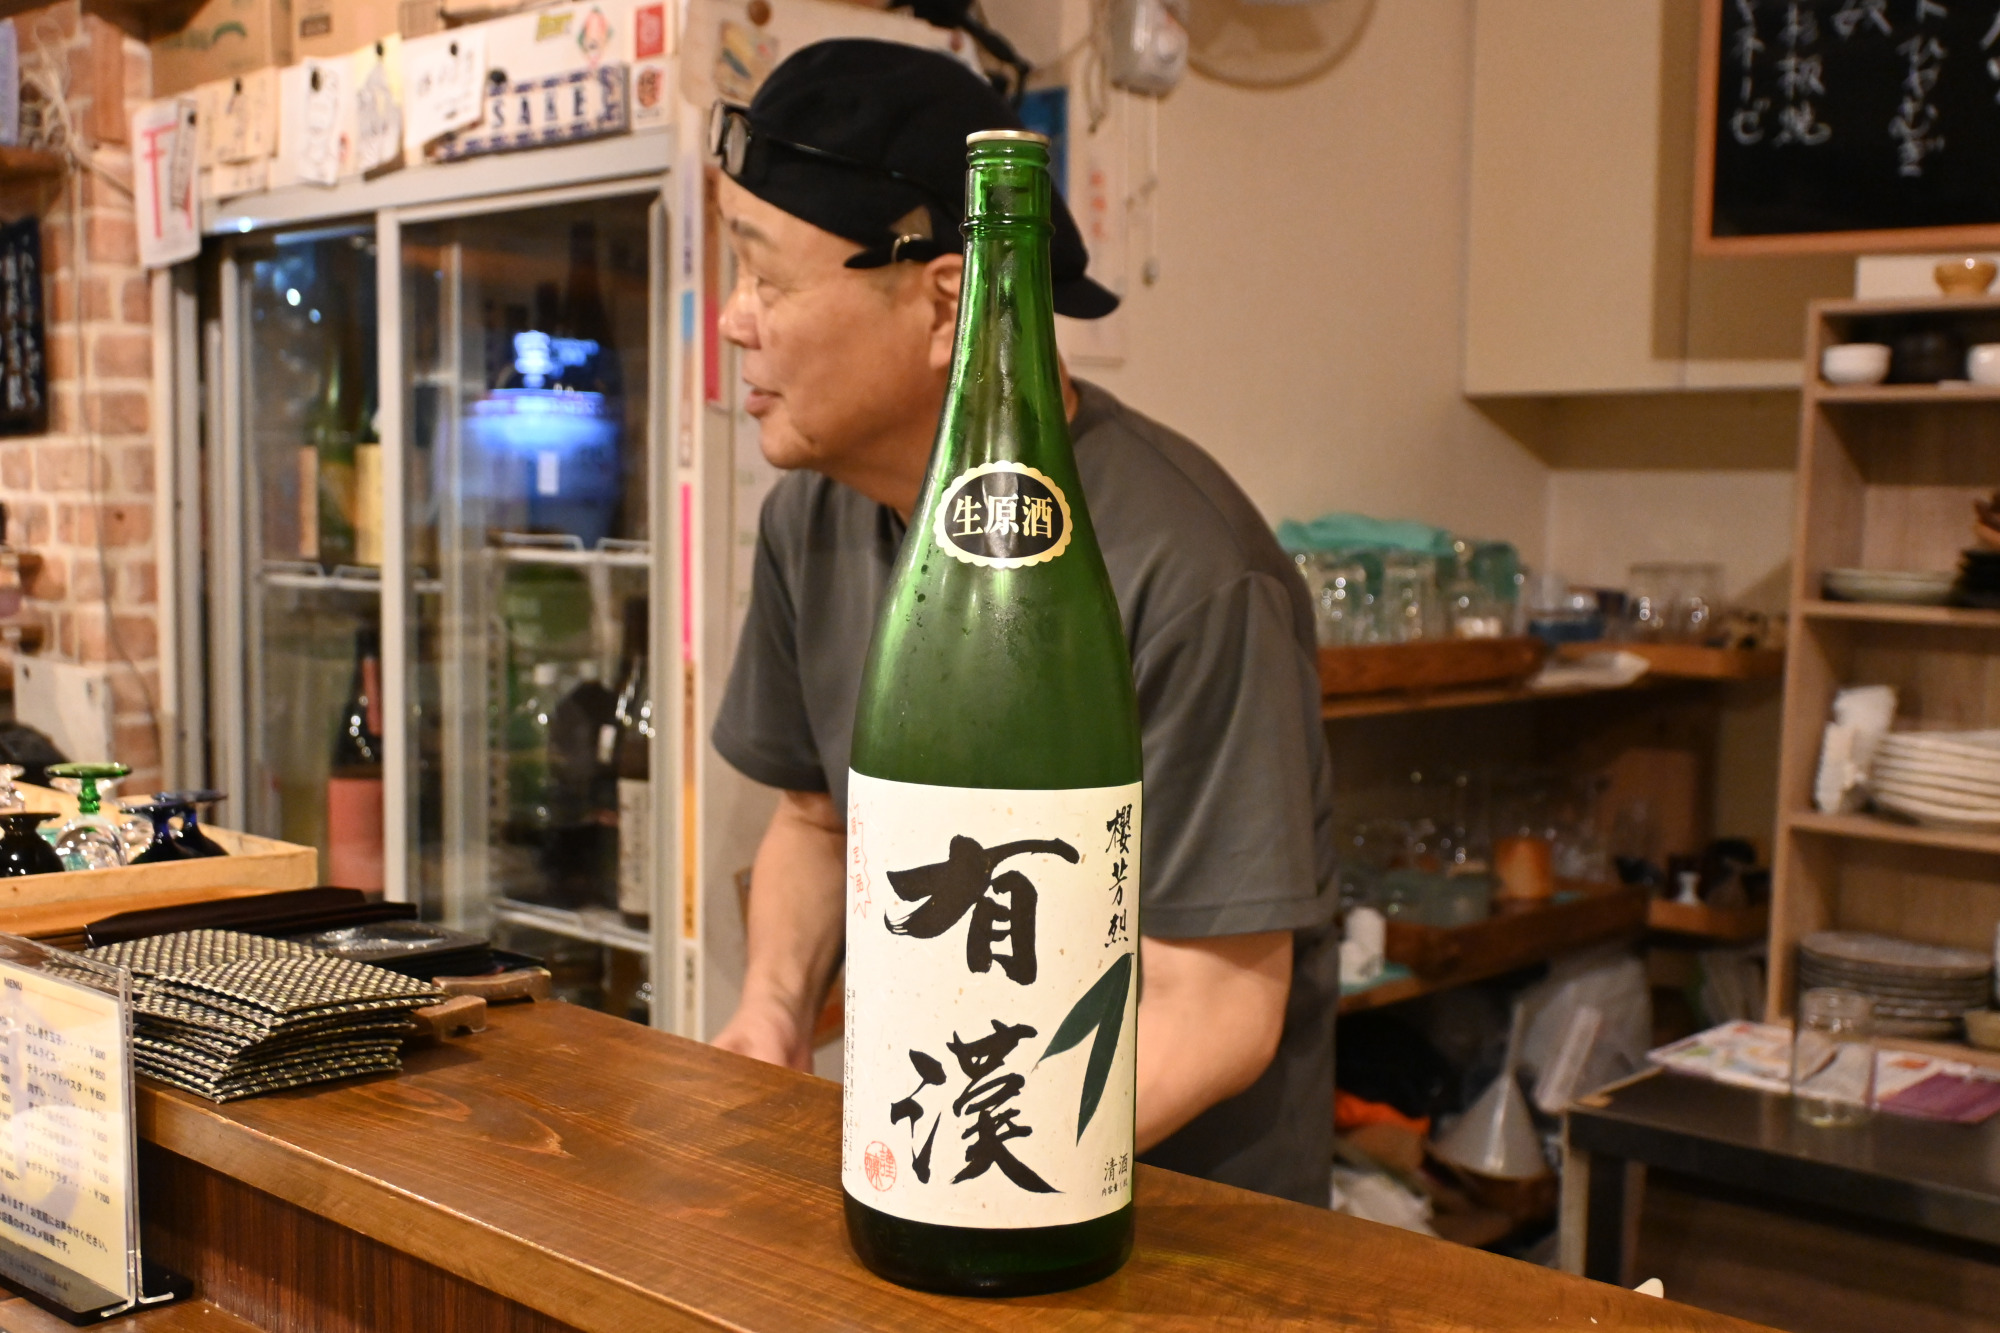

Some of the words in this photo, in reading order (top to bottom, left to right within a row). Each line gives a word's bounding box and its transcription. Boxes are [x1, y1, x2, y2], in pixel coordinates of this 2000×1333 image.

[952, 494, 1053, 539] 生原酒
[851, 816, 864, 893] 限定品
[1104, 803, 1133, 948] 櫻芳烈
[4, 977, 22, 991] MENU
[884, 834, 1080, 1195] 有漢
[1104, 1153, 1128, 1181] 清酒
